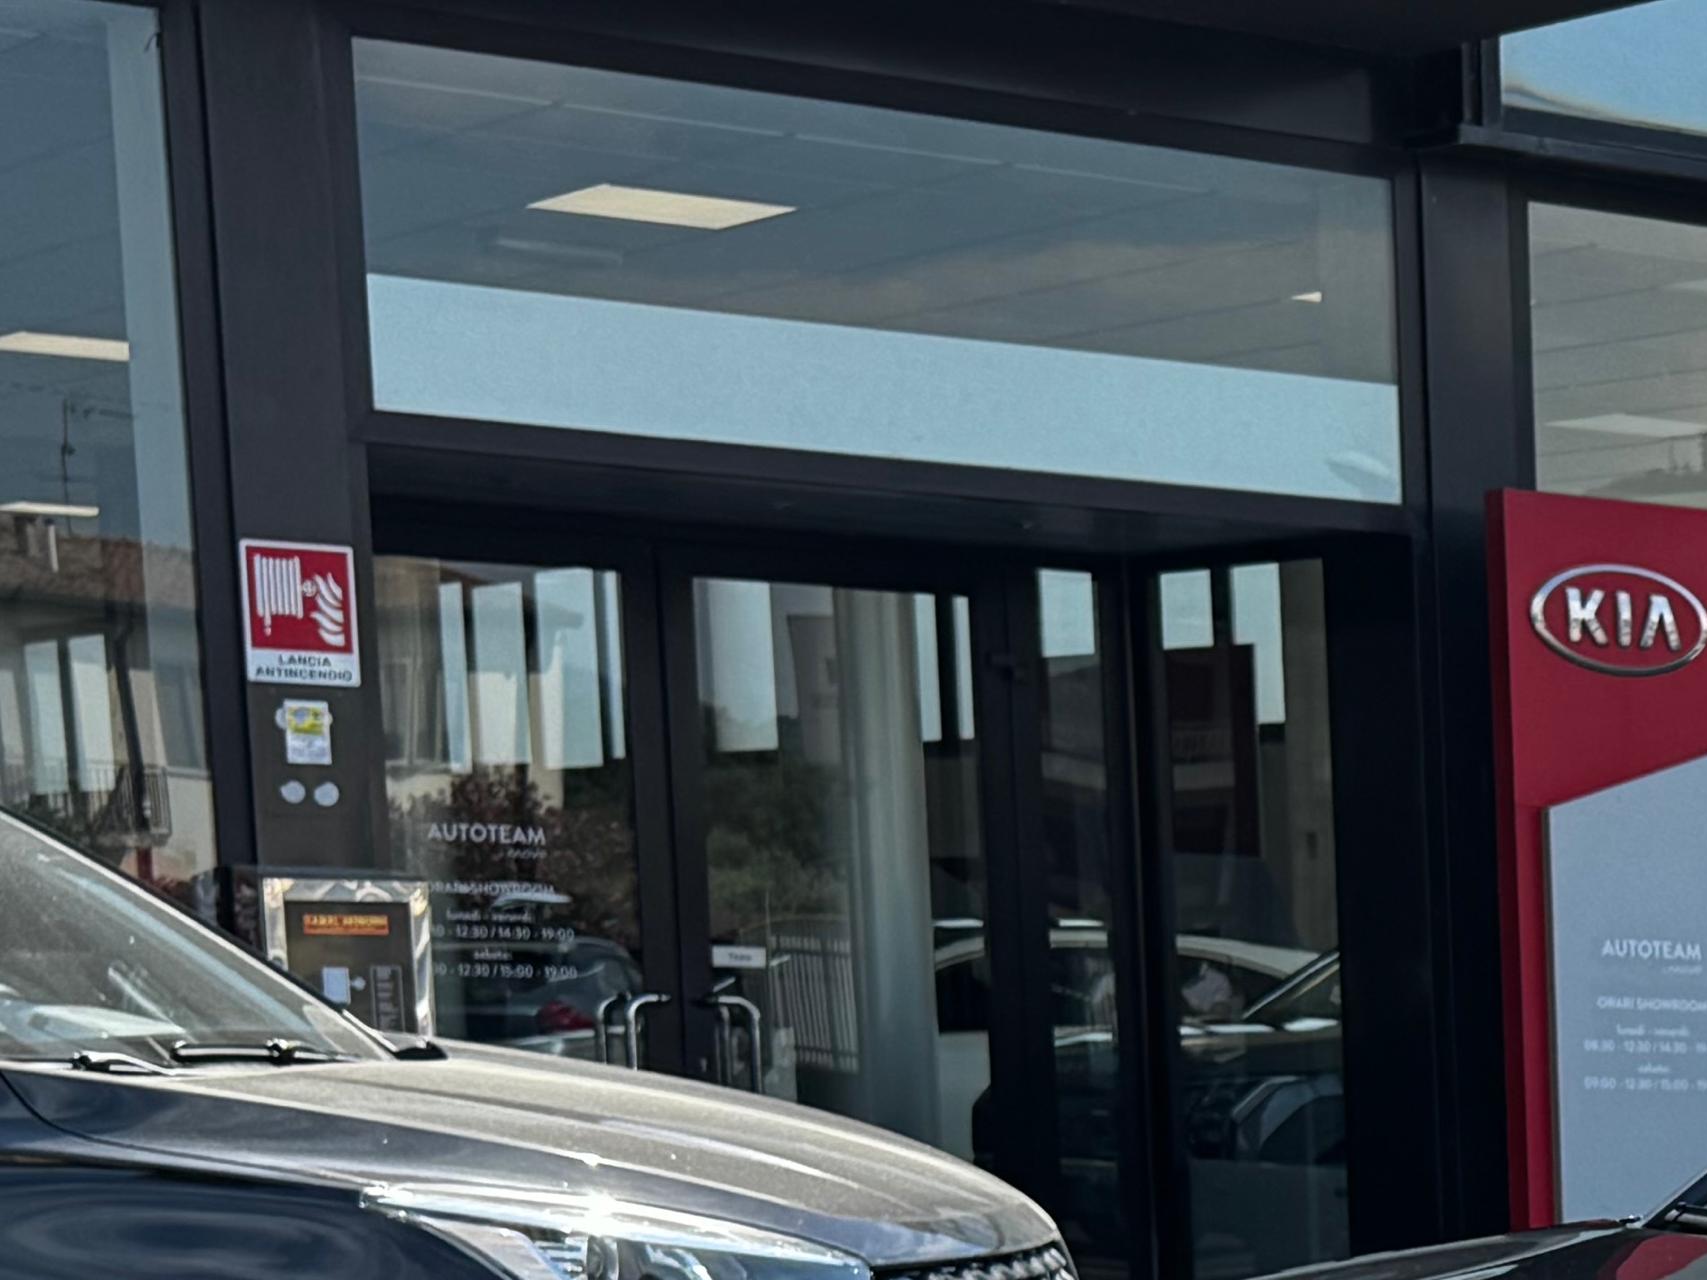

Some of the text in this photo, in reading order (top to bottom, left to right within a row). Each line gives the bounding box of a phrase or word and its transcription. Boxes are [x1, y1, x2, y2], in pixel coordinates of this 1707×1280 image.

[1566, 586, 1682, 651] KIA
[279, 654, 332, 667] LANCIA
[256, 666, 353, 682] ANTINCENDIO
[428, 822, 546, 845] AUTOTEAM
[1601, 939, 1702, 961] AUTOTEAM
